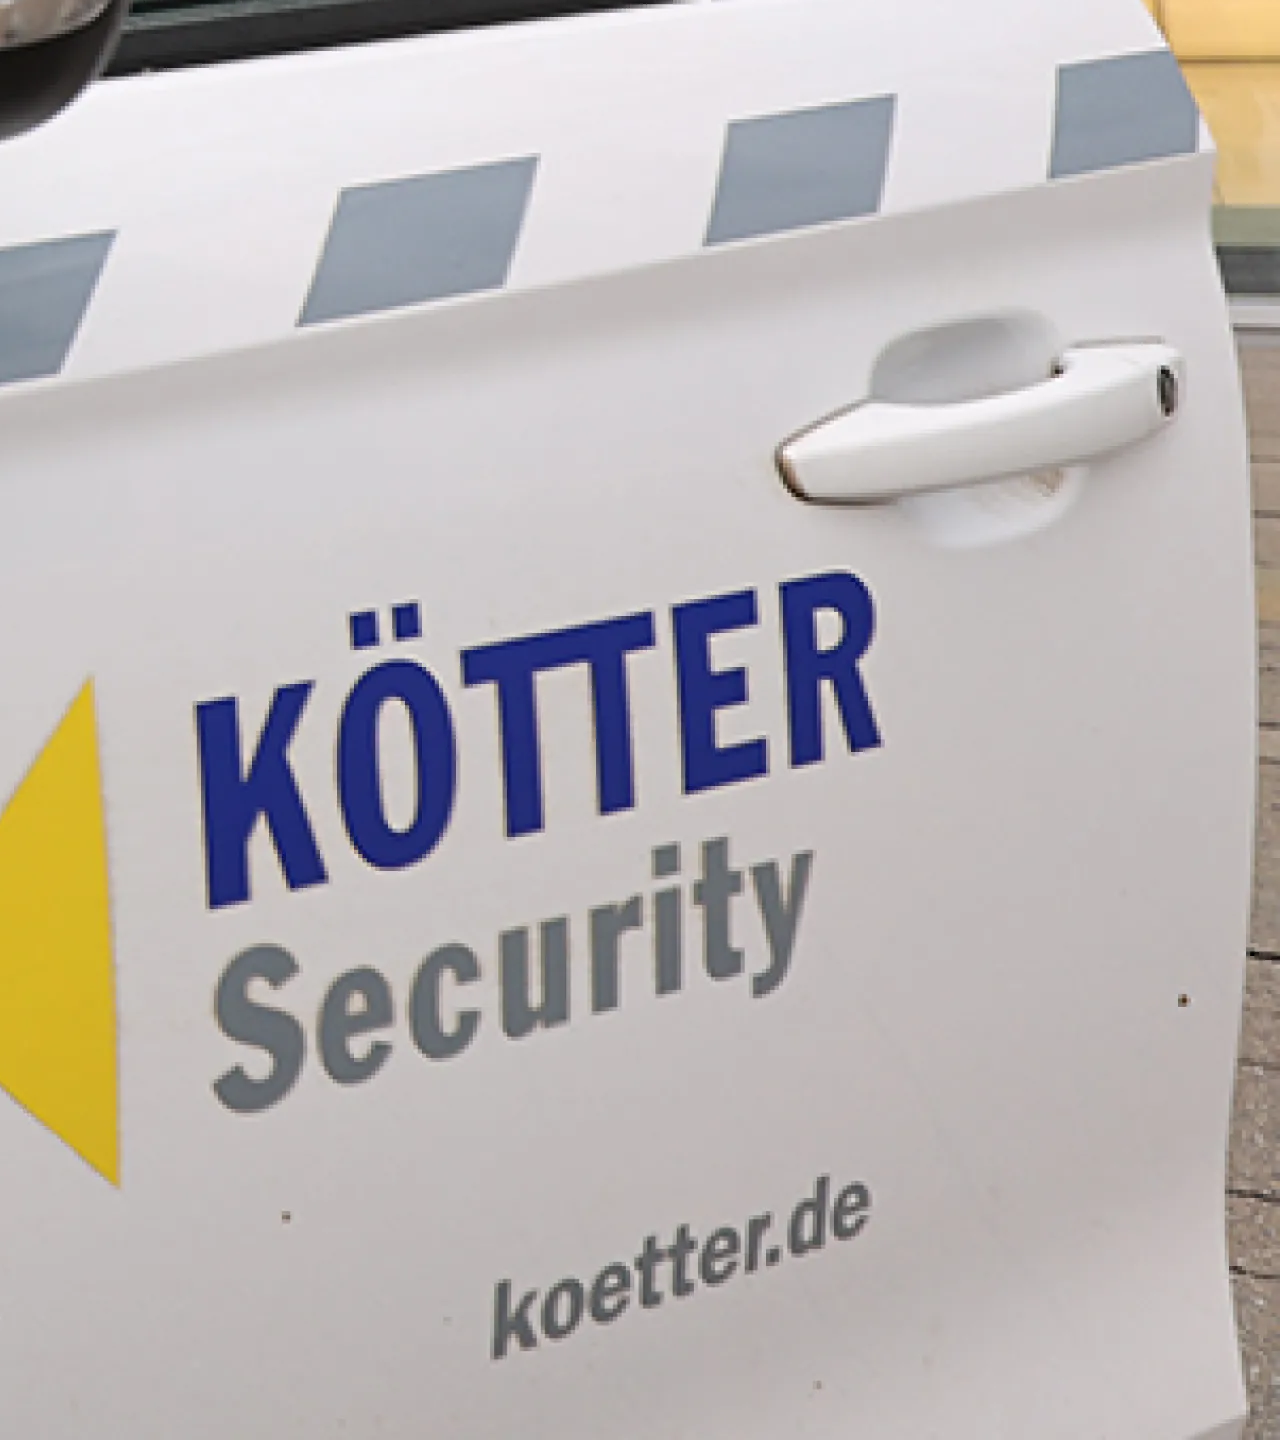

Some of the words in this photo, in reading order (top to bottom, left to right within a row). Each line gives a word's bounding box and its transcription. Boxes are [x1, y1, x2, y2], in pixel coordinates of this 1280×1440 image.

[195, 571, 881, 910] KÖTTER
[211, 835, 815, 1115] Security
[489, 1173, 872, 1360] koetter.de
